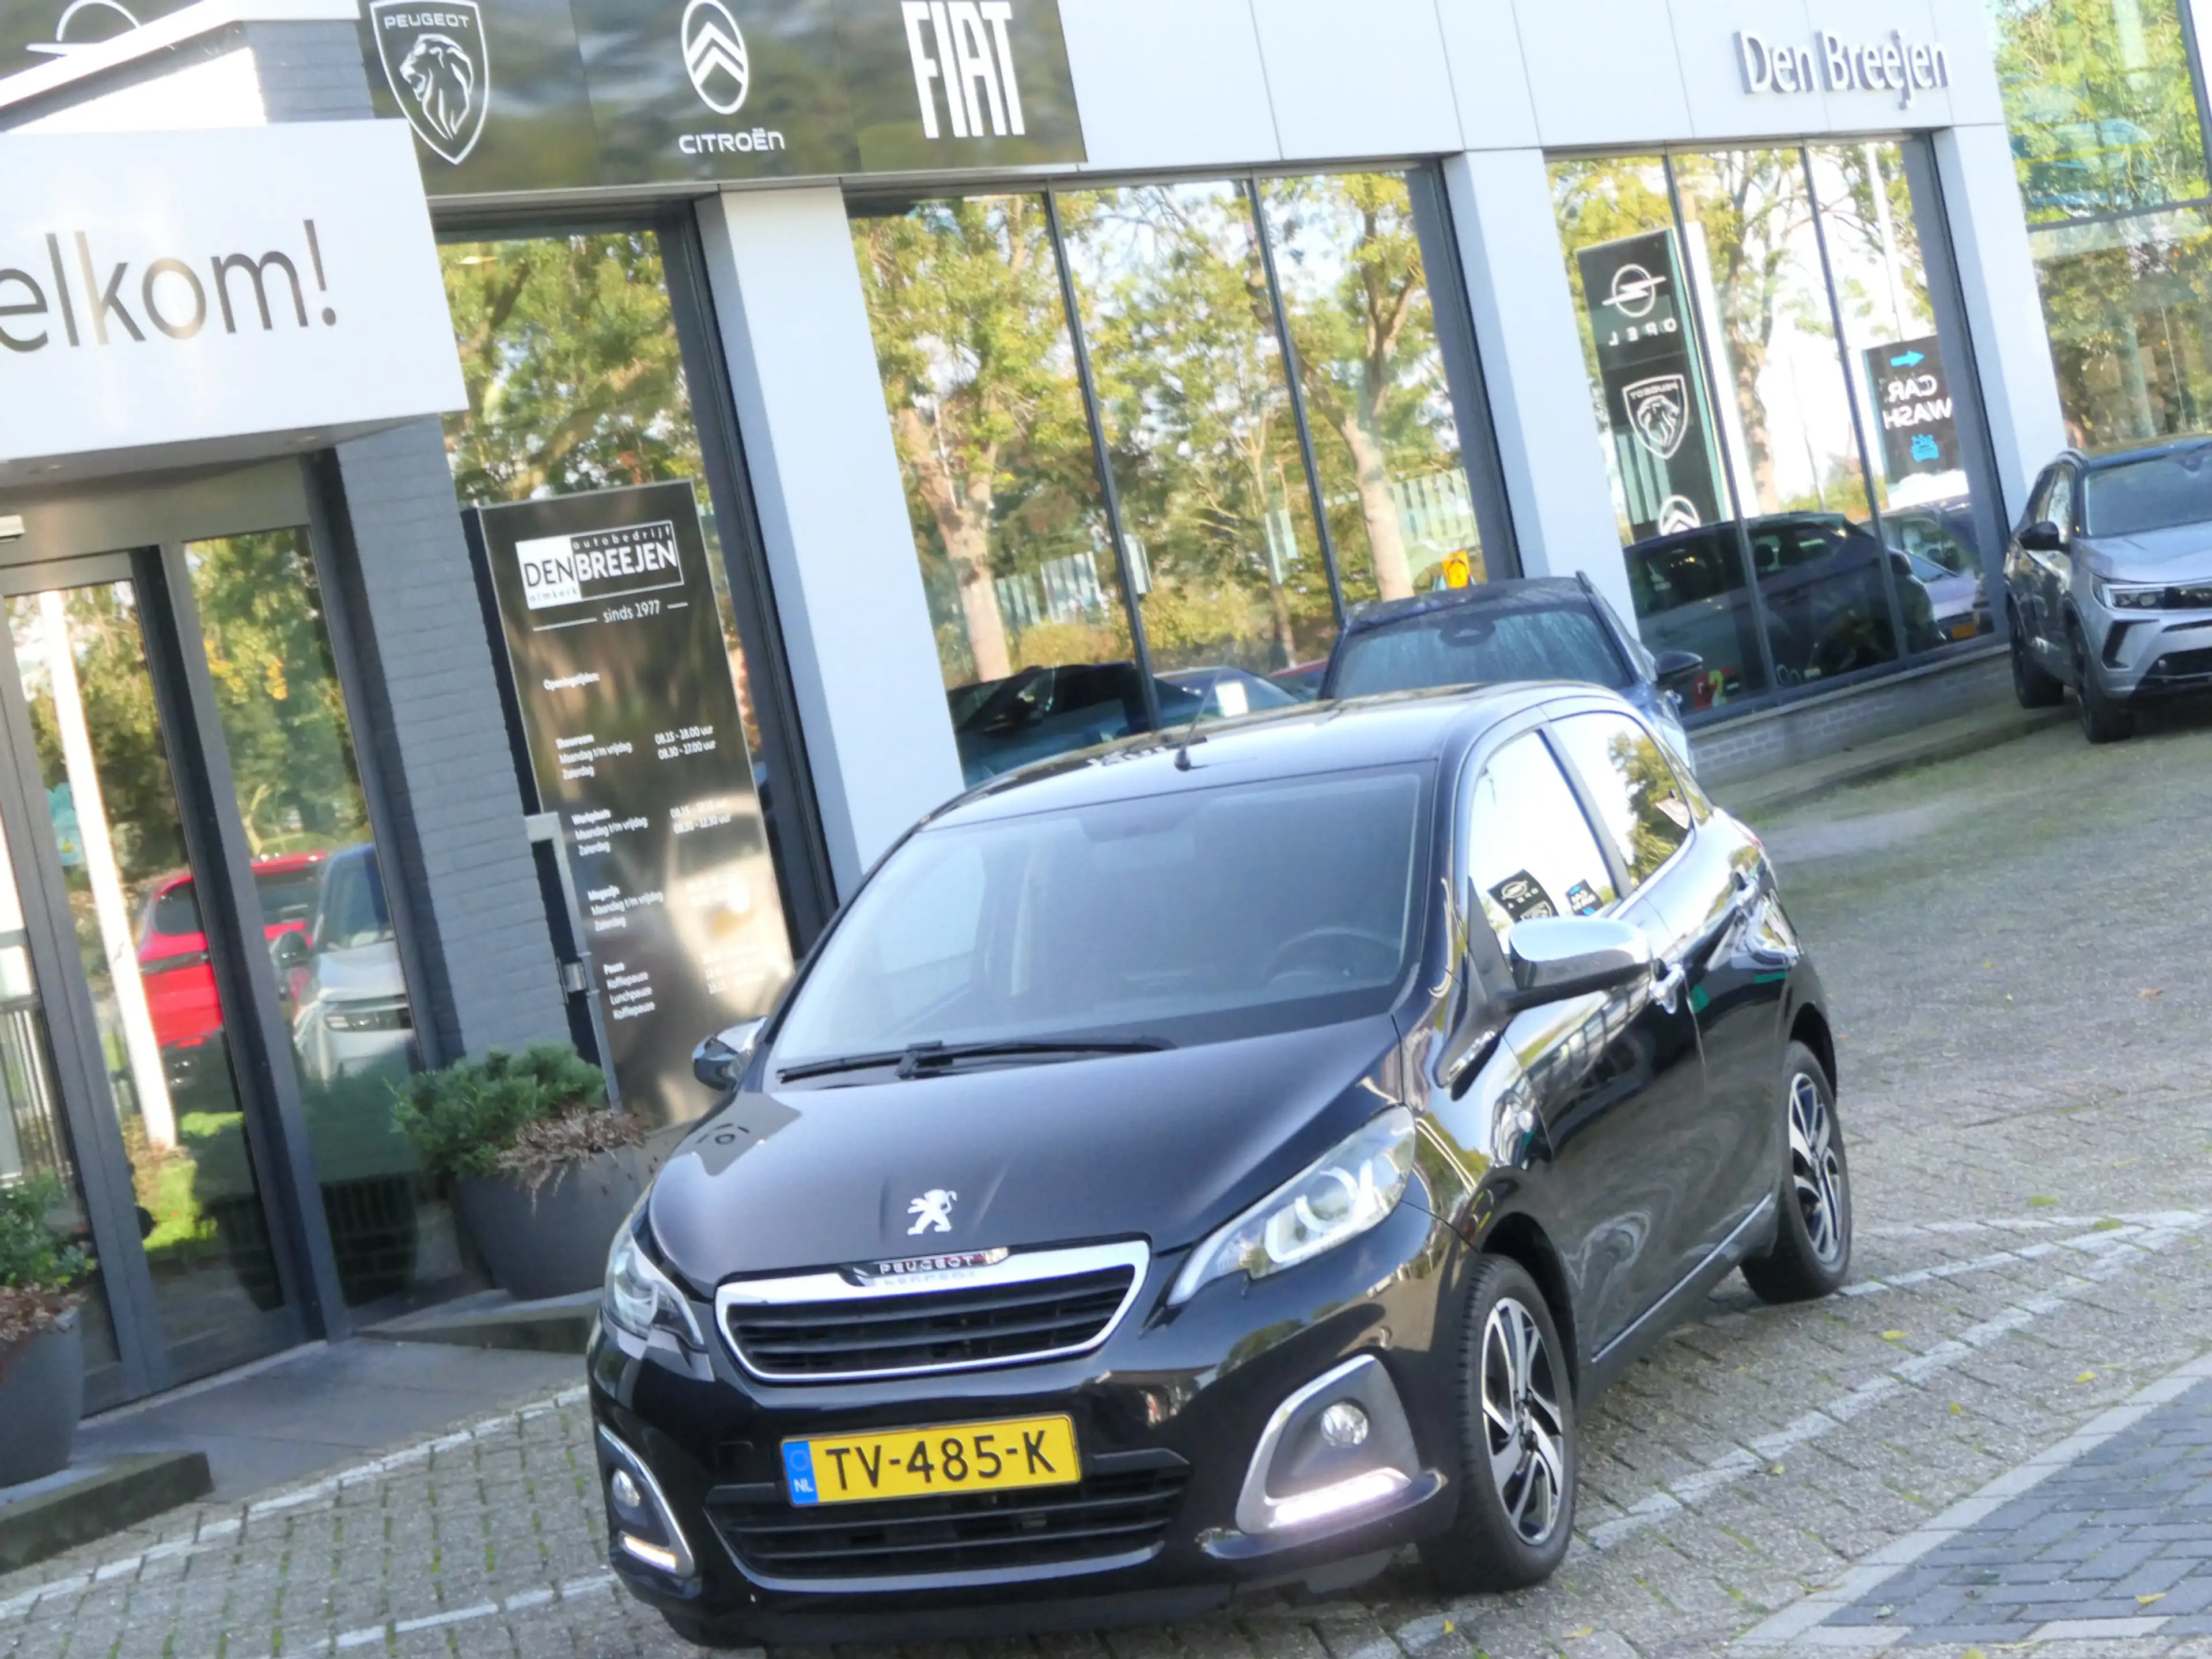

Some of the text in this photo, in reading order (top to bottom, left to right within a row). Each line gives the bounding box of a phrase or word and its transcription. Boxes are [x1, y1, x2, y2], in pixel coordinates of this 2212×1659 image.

[384, 13, 471, 29] PEUGEOT
[900, 1, 1025, 139] FIAT
[1733, 29, 1952, 110] Den Breejen
[573, 525, 671, 550] autobedrijf
[524, 540, 677, 587] DEN BREEJEN
[603, 600, 660, 623] sinds 1977
[880, 1255, 975, 1274] PEUGEOT
[825, 1430, 1056, 1491] TV-485-K
[793, 1477, 813, 1494] NL
